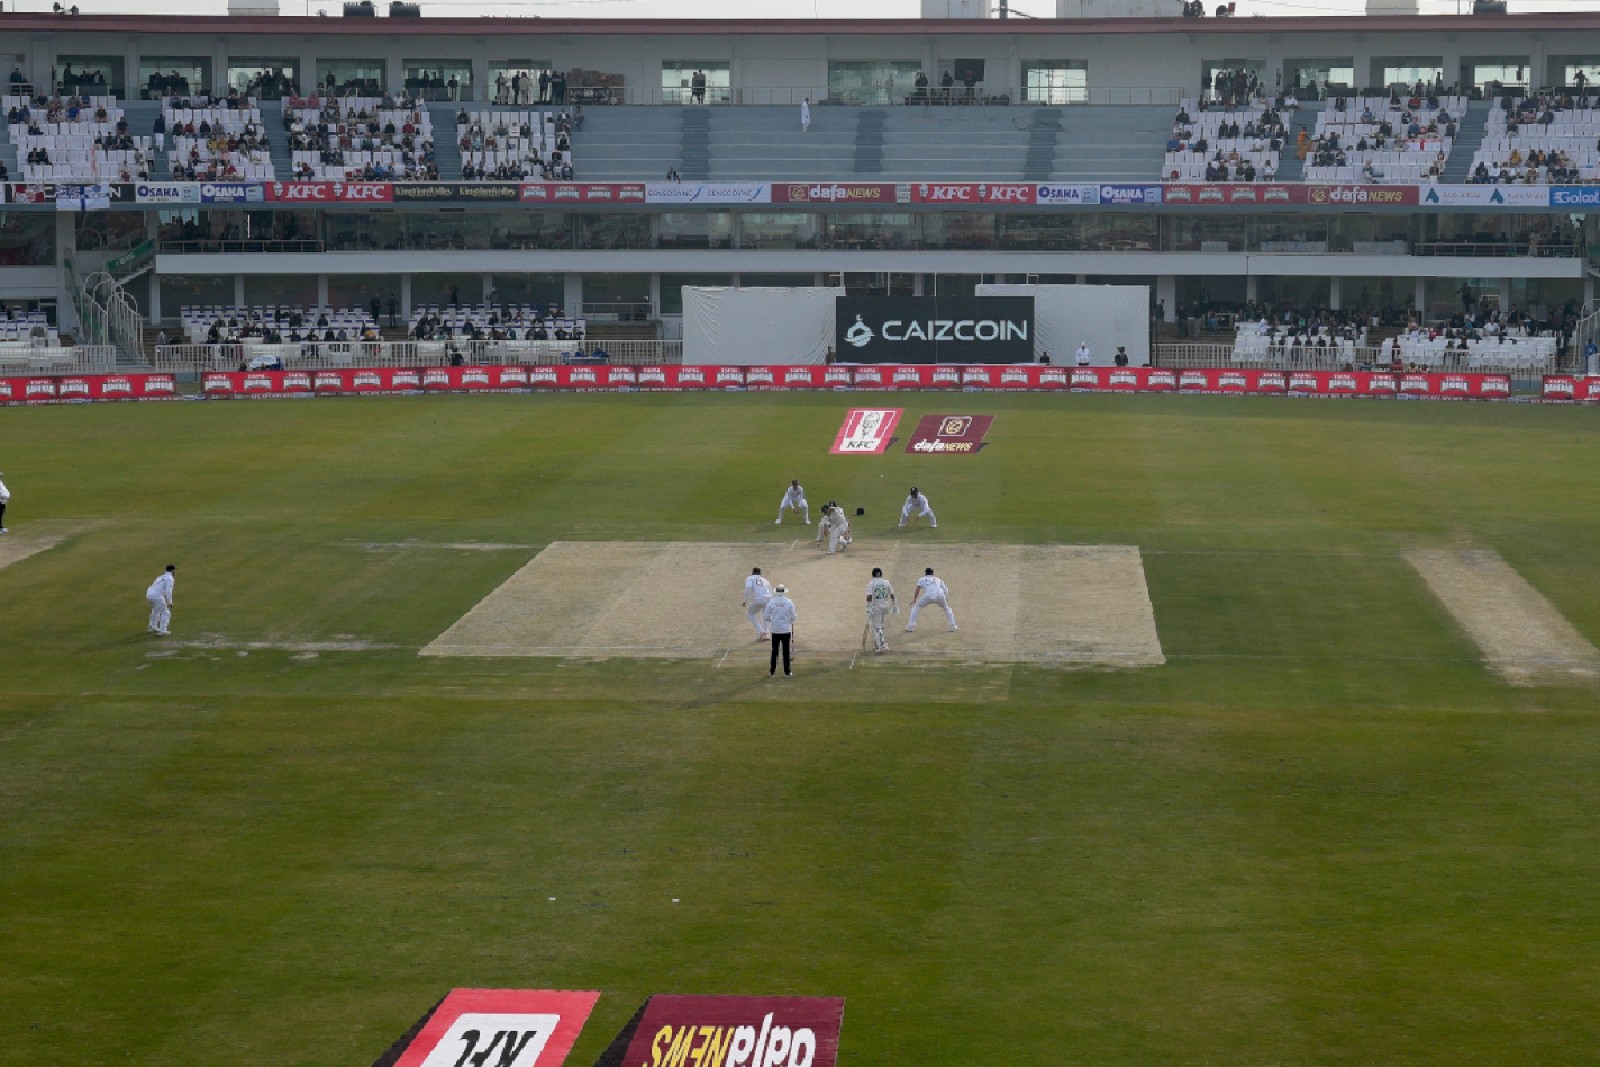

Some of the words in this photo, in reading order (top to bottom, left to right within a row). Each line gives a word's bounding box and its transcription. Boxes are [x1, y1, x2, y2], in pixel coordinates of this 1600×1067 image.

[137, 185, 179, 197] OSAKA
[202, 184, 245, 197] OSAKA
[285, 185, 326, 198] KFC
[345, 185, 385, 198] KFC
[931, 186, 971, 200] KFC
[990, 186, 1028, 201] KFC
[1039, 186, 1079, 198] OSAKA
[1101, 186, 1143, 199] OSAKA
[882, 320, 1027, 341] CAIZCOIN
